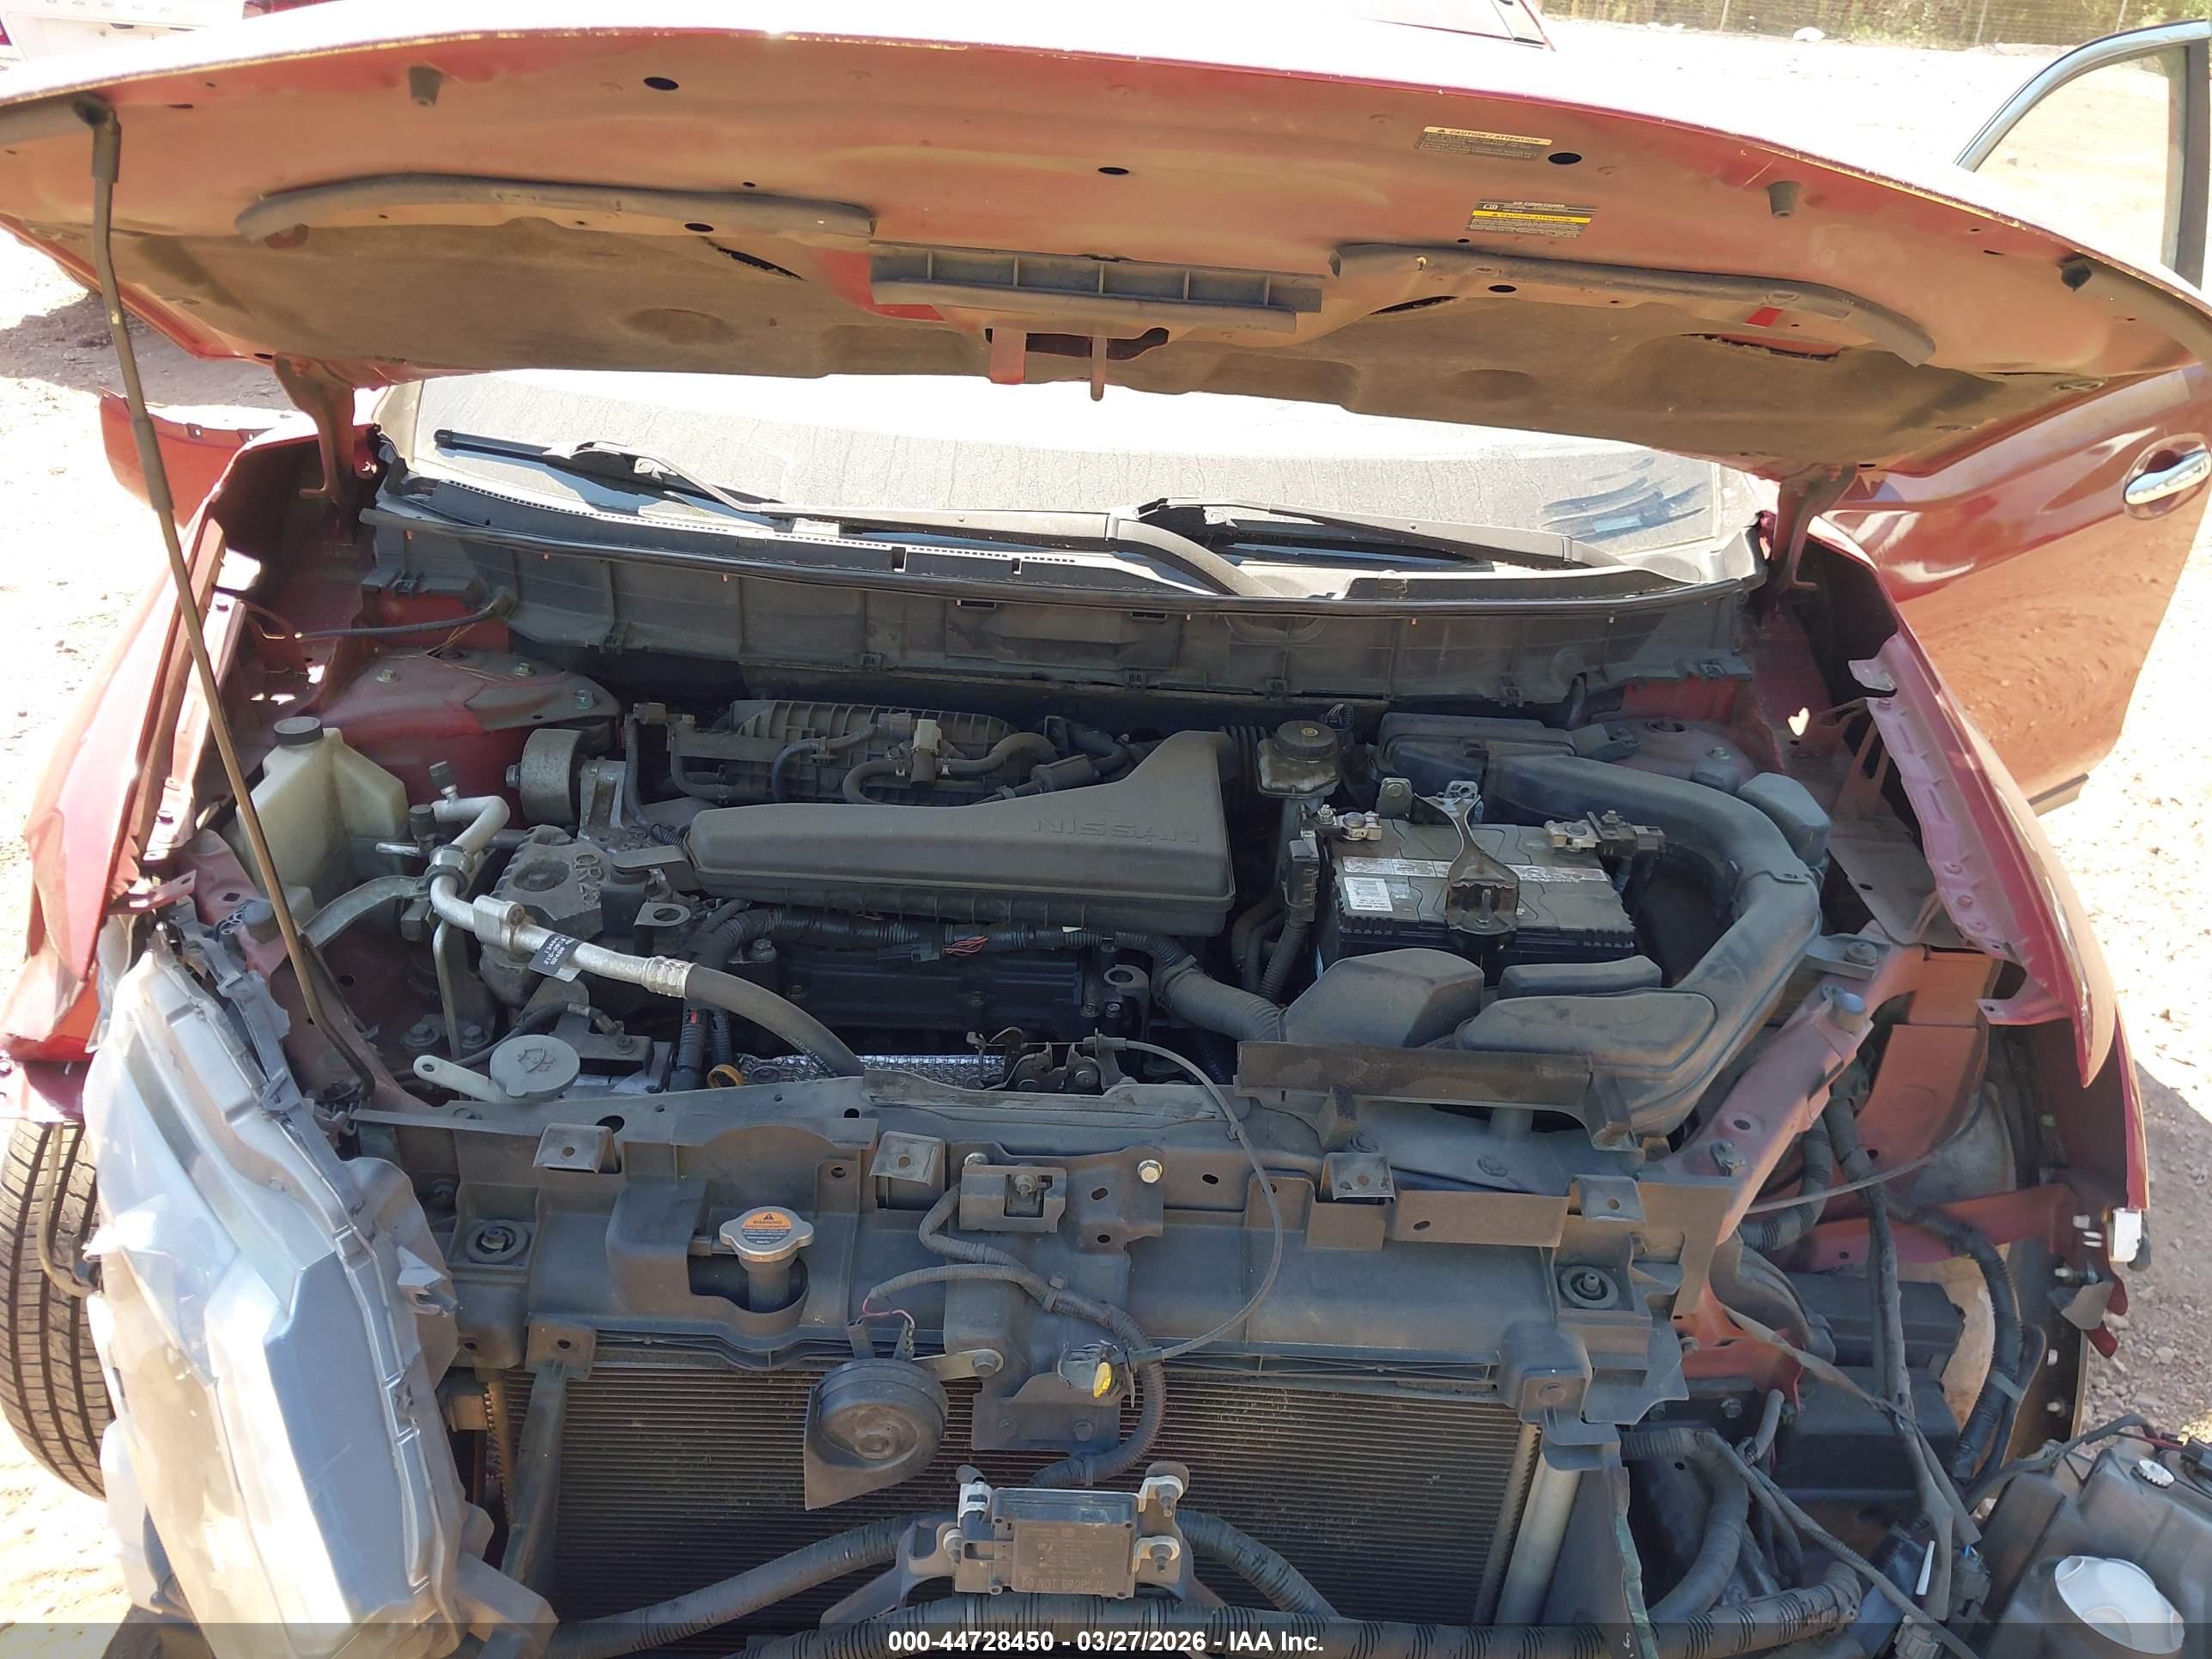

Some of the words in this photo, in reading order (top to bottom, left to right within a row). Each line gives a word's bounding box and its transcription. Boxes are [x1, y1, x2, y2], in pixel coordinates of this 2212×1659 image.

[1496, 134, 1540, 143] ATTENTION
[1032, 817, 1200, 842] NISSAN
[1021, 1578, 1034, 1588] DO
[1037, 1578, 1057, 1589] NOT
